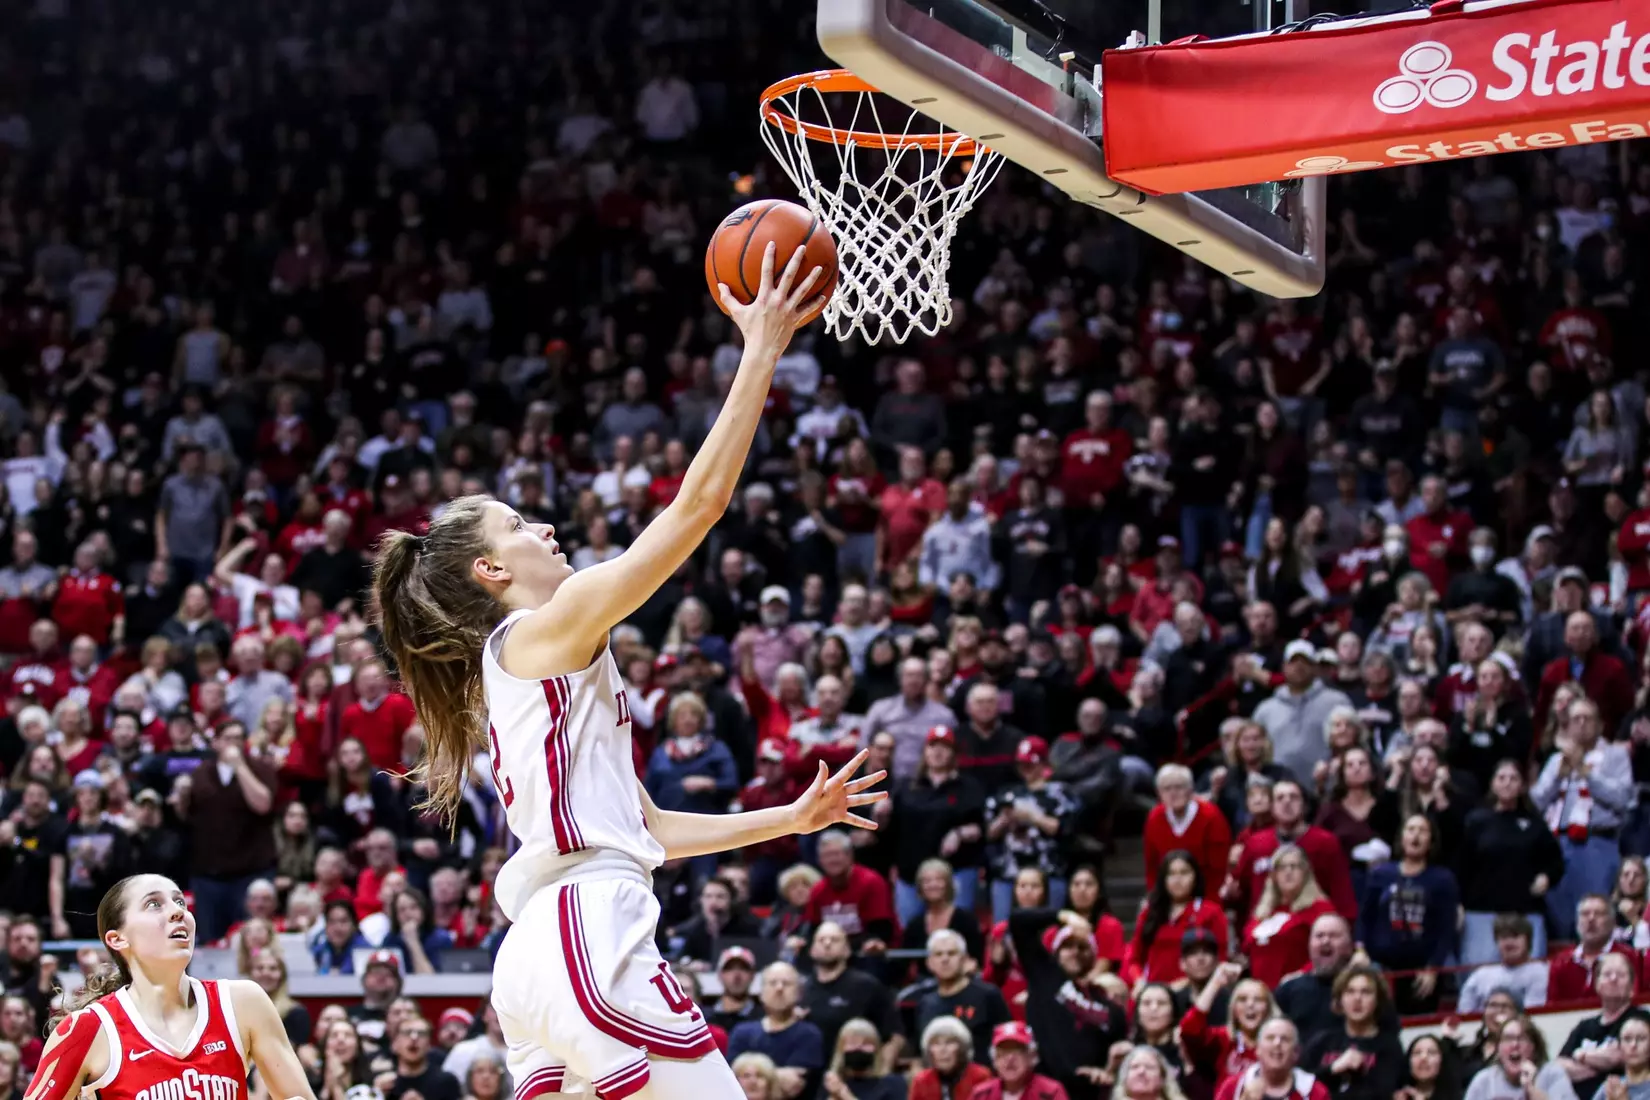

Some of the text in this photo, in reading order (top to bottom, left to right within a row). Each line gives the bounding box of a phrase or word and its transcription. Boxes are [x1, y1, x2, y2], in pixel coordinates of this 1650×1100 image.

[1485, 20, 1650, 101] State
[1385, 119, 1650, 164] State Fa
